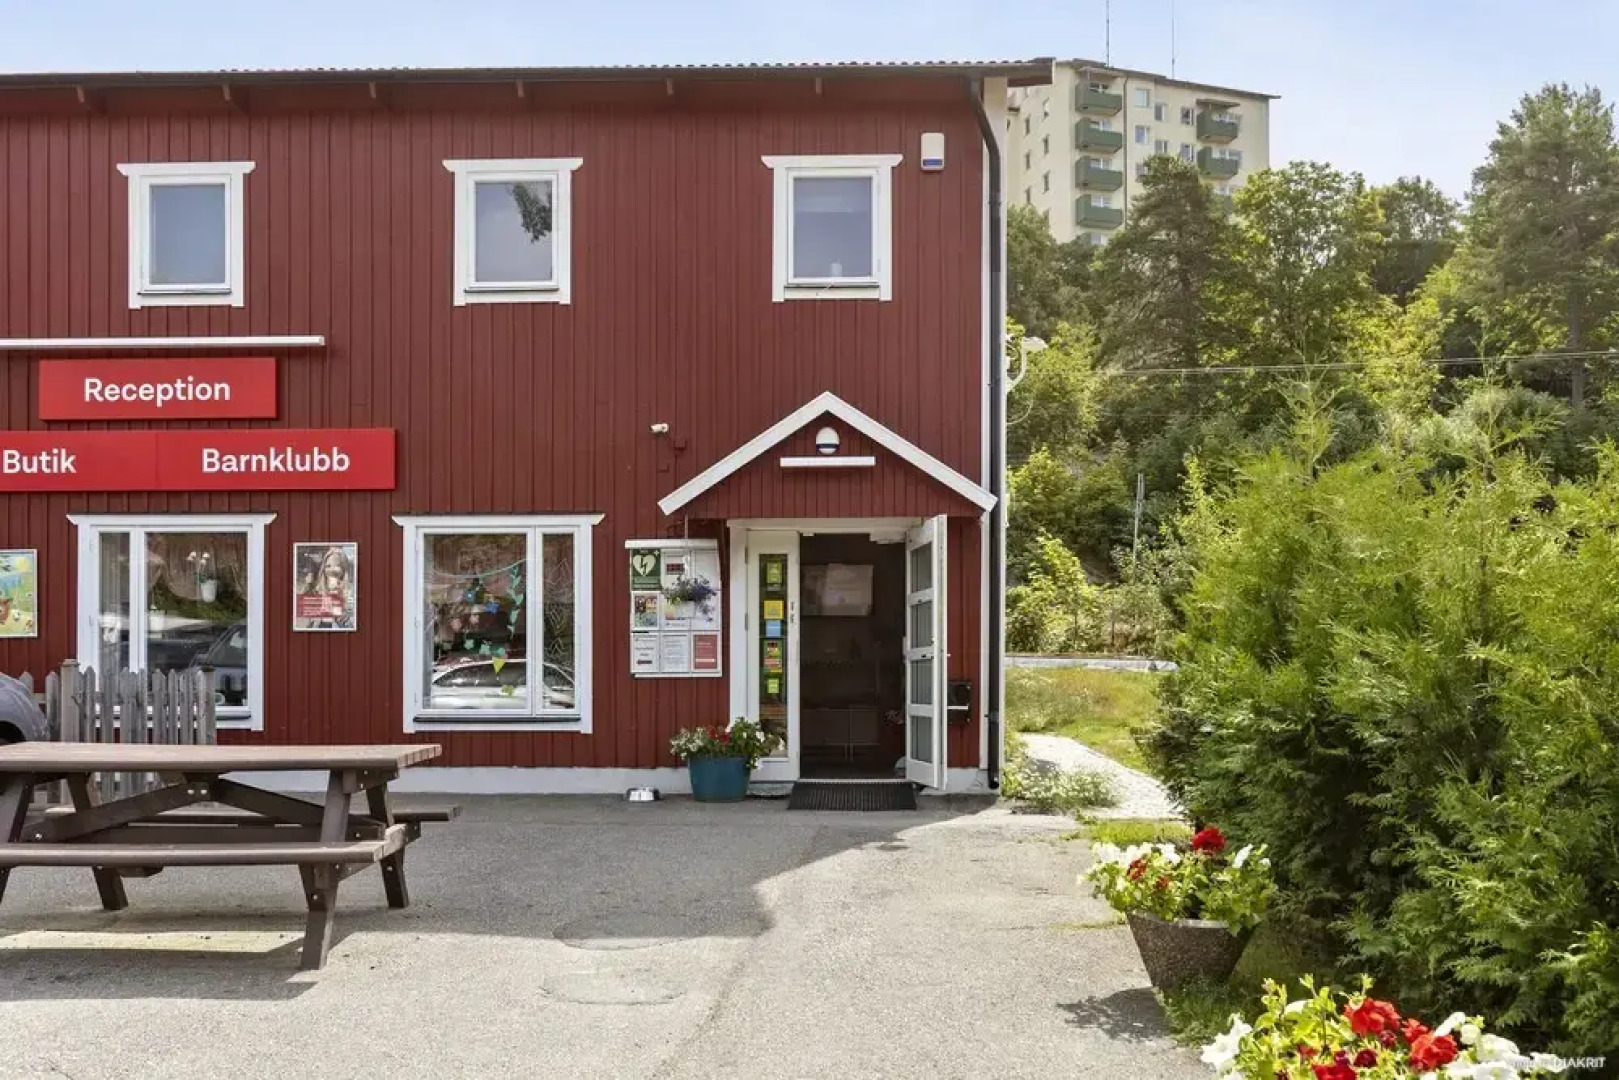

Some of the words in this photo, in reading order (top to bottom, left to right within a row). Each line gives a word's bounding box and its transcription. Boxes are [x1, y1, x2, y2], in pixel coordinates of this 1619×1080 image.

[83, 376, 231, 408] Reception
[2, 449, 77, 474] Butik
[202, 447, 351, 473] Barnklubb
